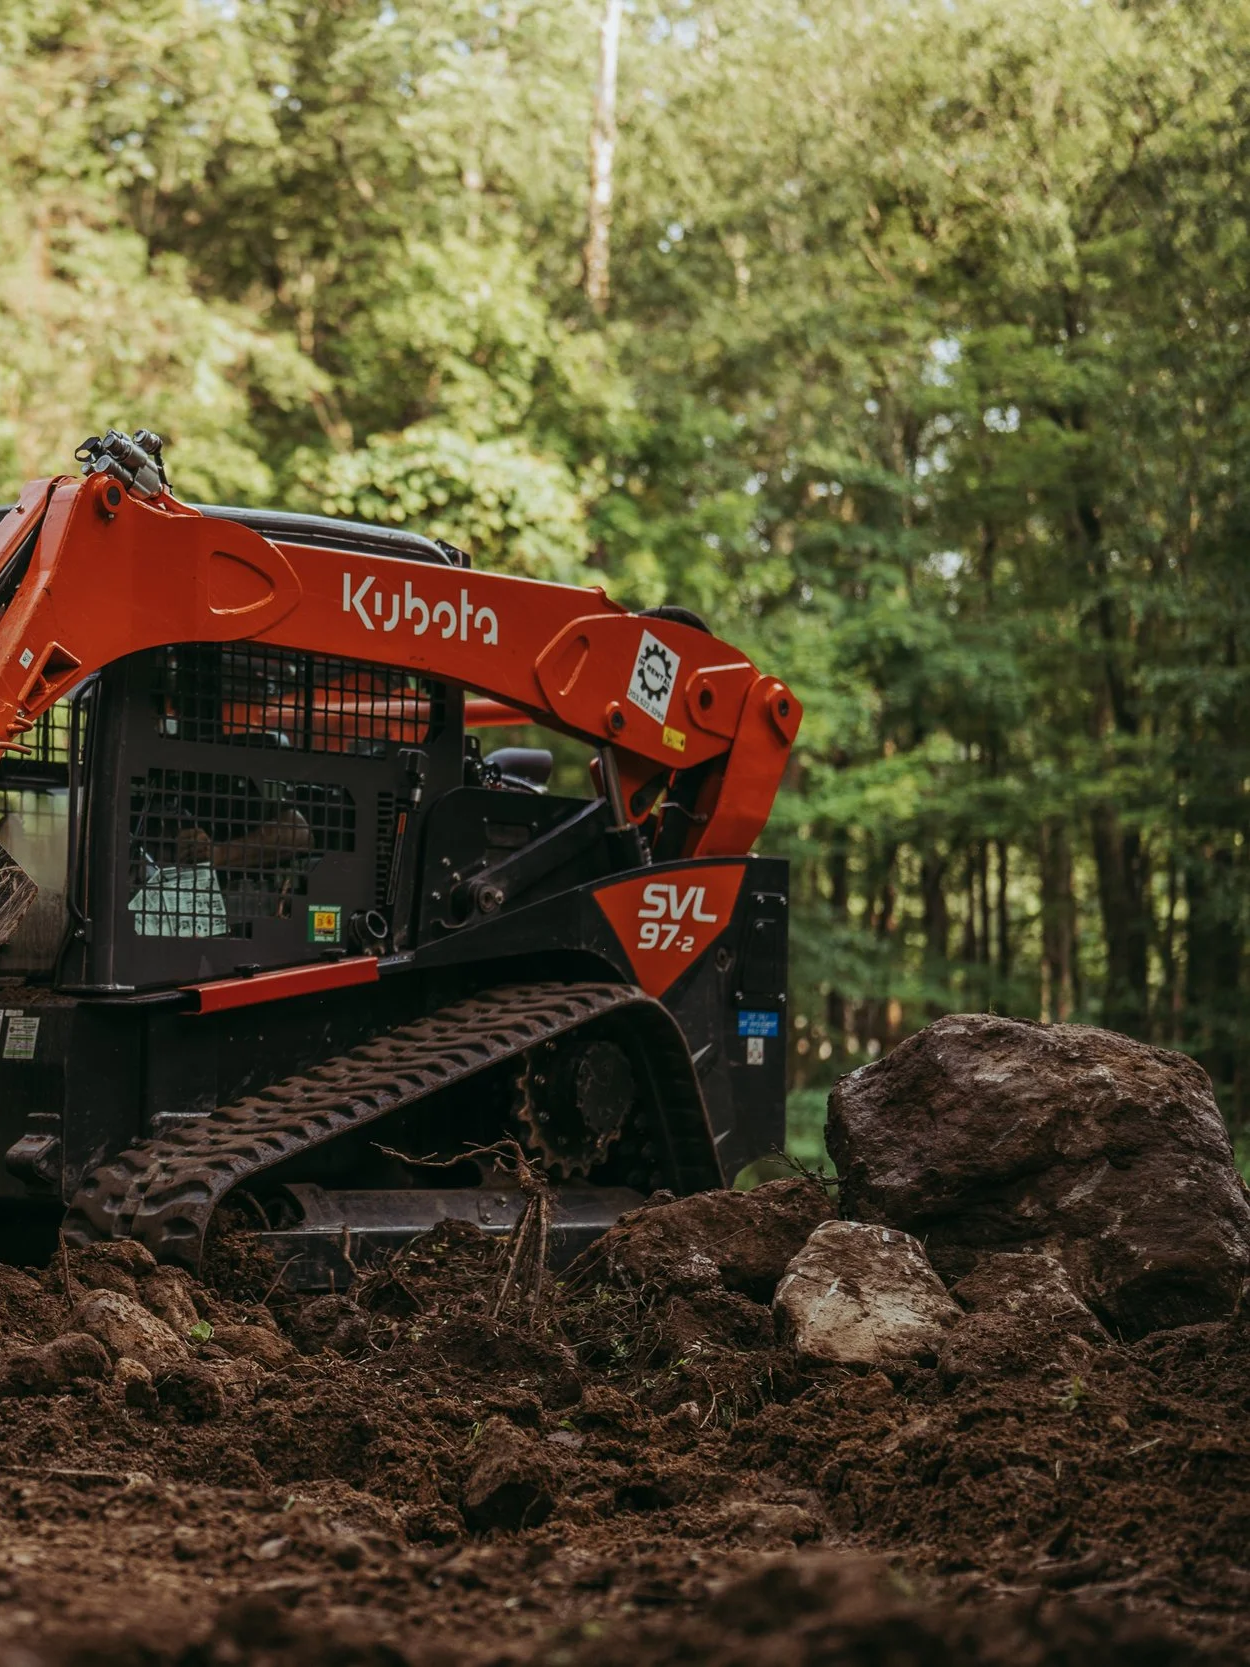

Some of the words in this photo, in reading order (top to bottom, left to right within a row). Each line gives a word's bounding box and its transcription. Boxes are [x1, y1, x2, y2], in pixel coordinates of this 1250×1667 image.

[343, 572, 498, 645] Kubota
[646, 664, 671, 689] RENTAL
[638, 883, 718, 923] SVL
